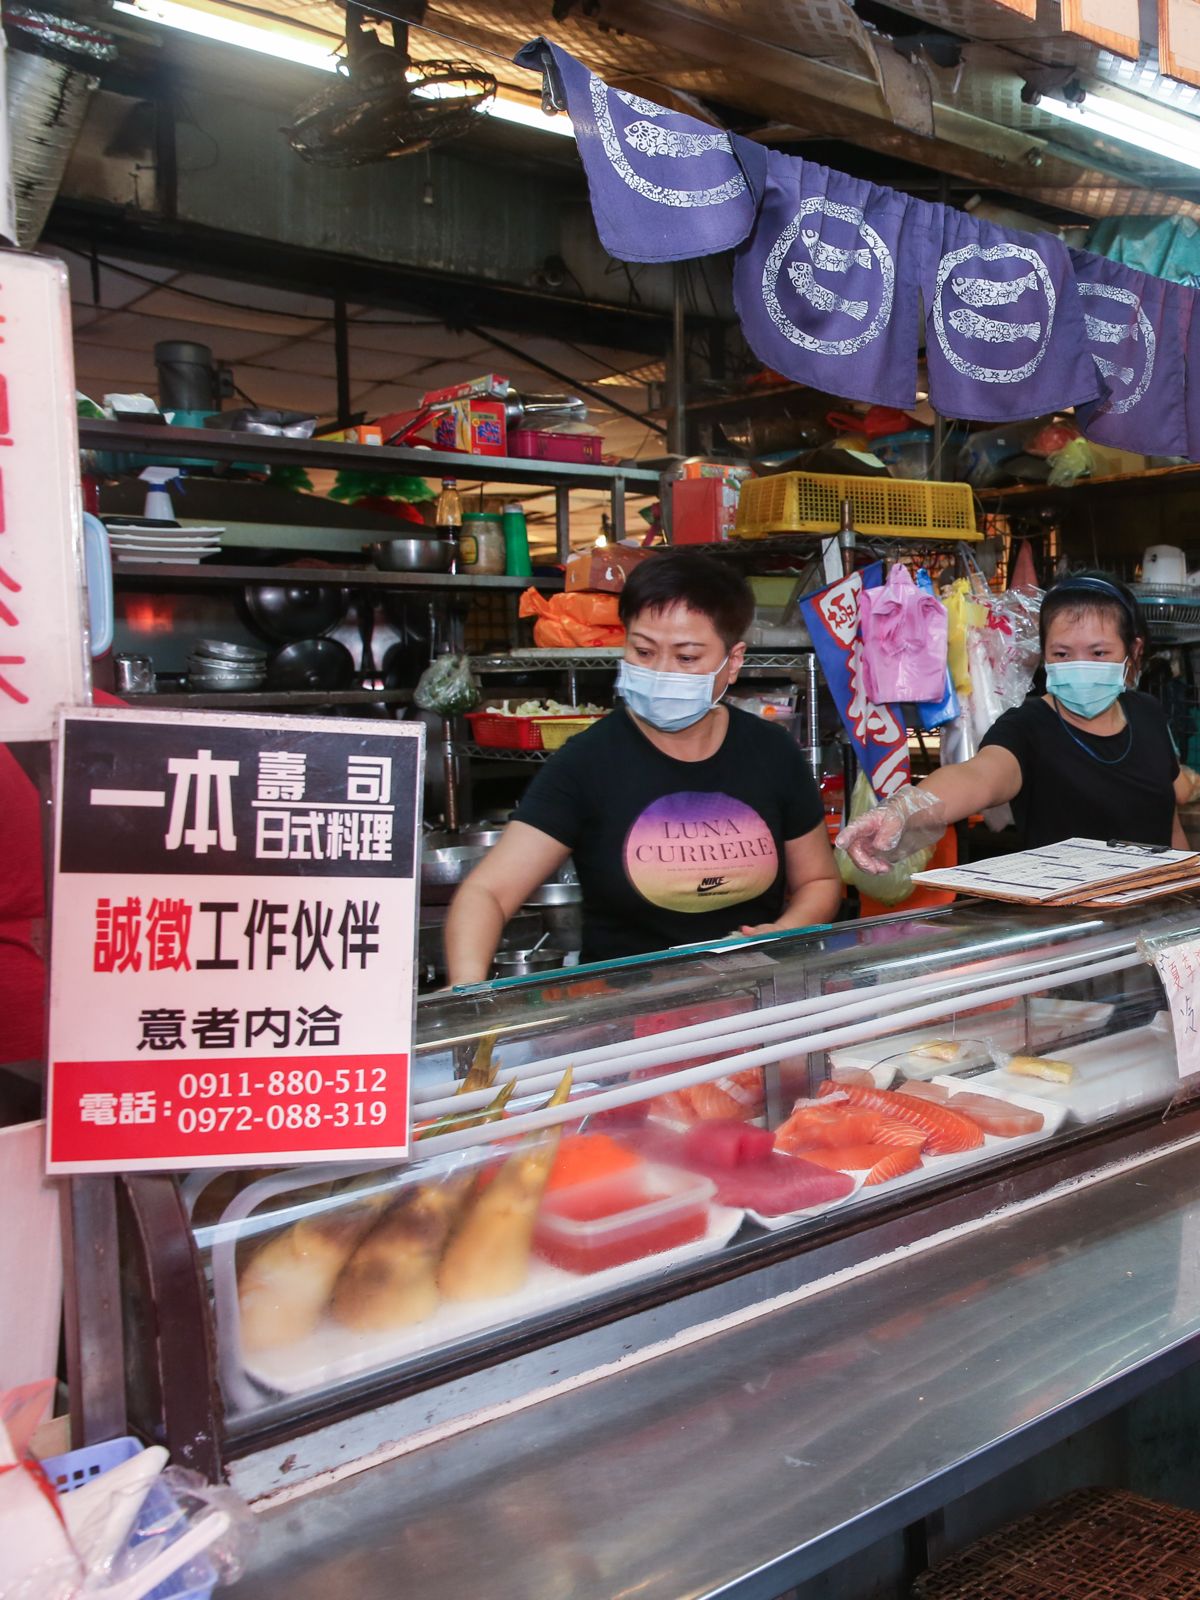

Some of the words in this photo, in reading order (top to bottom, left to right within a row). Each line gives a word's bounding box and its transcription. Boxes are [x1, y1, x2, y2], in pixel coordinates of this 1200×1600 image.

[257, 752, 393, 803] 壽司
[90, 750, 239, 853] 一本
[256, 811, 393, 861] 日式料理
[664, 818, 740, 839] LUNA
[636, 837, 774, 863] CURRERE
[702, 876, 724, 885] NIKE
[93, 897, 380, 972] 誠徵工作伙伴
[179, 1068, 386, 1100] 0911-880-512
[79, 1090, 172, 1126] 電話:
[178, 1101, 386, 1134] 0972-088-319
